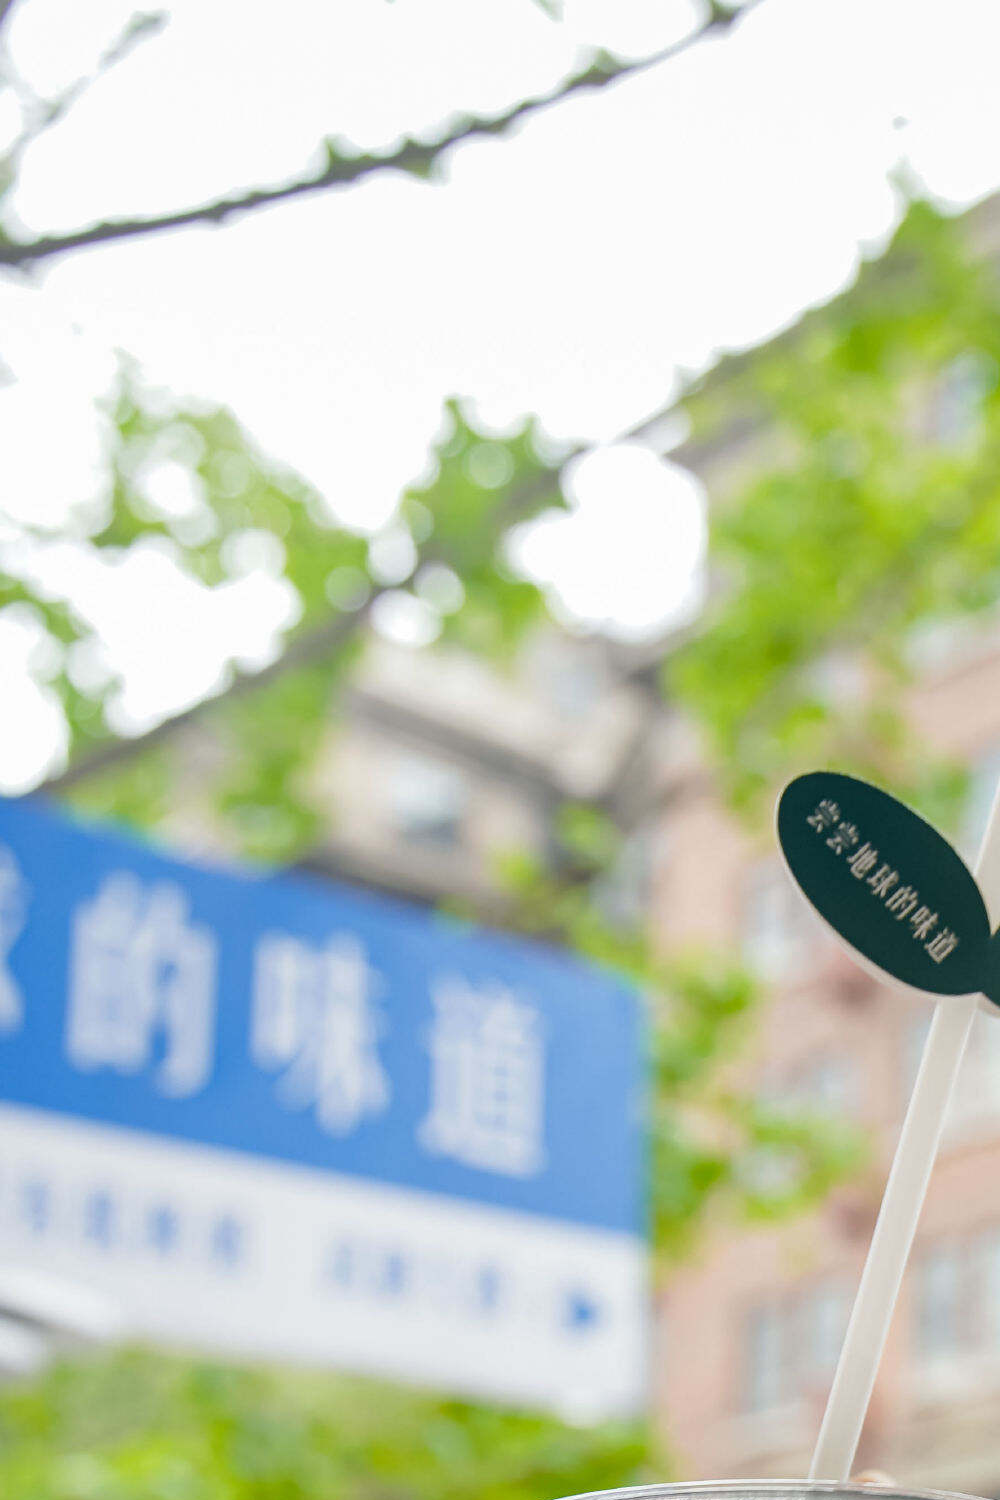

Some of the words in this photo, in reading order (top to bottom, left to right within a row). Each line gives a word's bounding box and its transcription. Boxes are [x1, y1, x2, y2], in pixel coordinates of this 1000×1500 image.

[0, 838, 549, 1178] 的味道
[806, 798, 960, 965] 尝尝地球的味道
